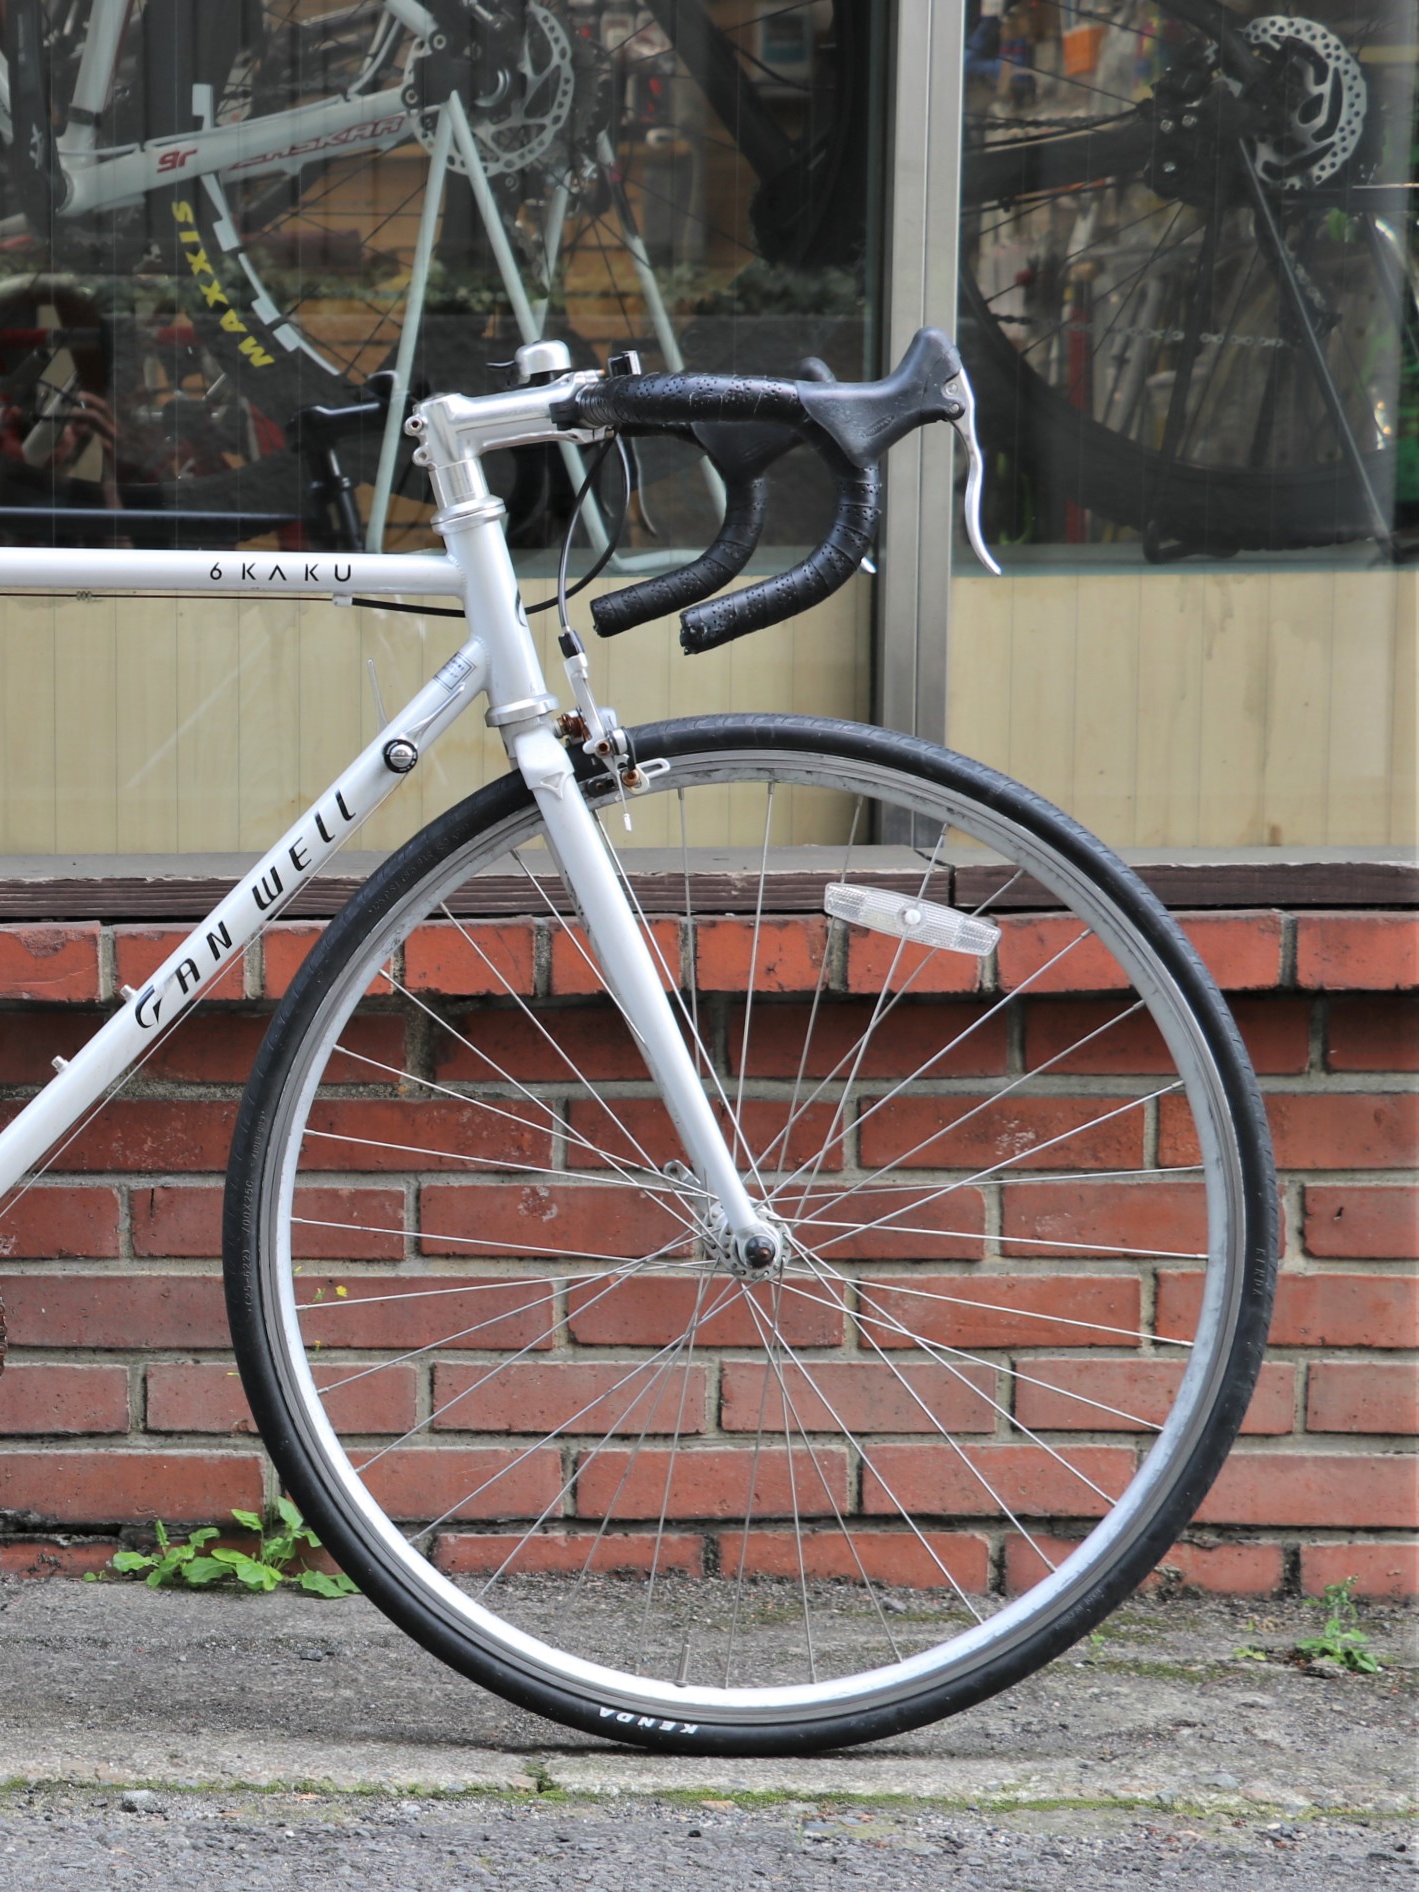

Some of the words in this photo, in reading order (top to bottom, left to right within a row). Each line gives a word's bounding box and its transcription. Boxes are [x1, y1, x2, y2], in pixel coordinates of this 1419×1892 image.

[171, 200, 276, 368] MAXXIS
[134, 919, 233, 1030] GAN
[250, 787, 357, 912] WELL
[599, 1706, 699, 1735] KENDA
